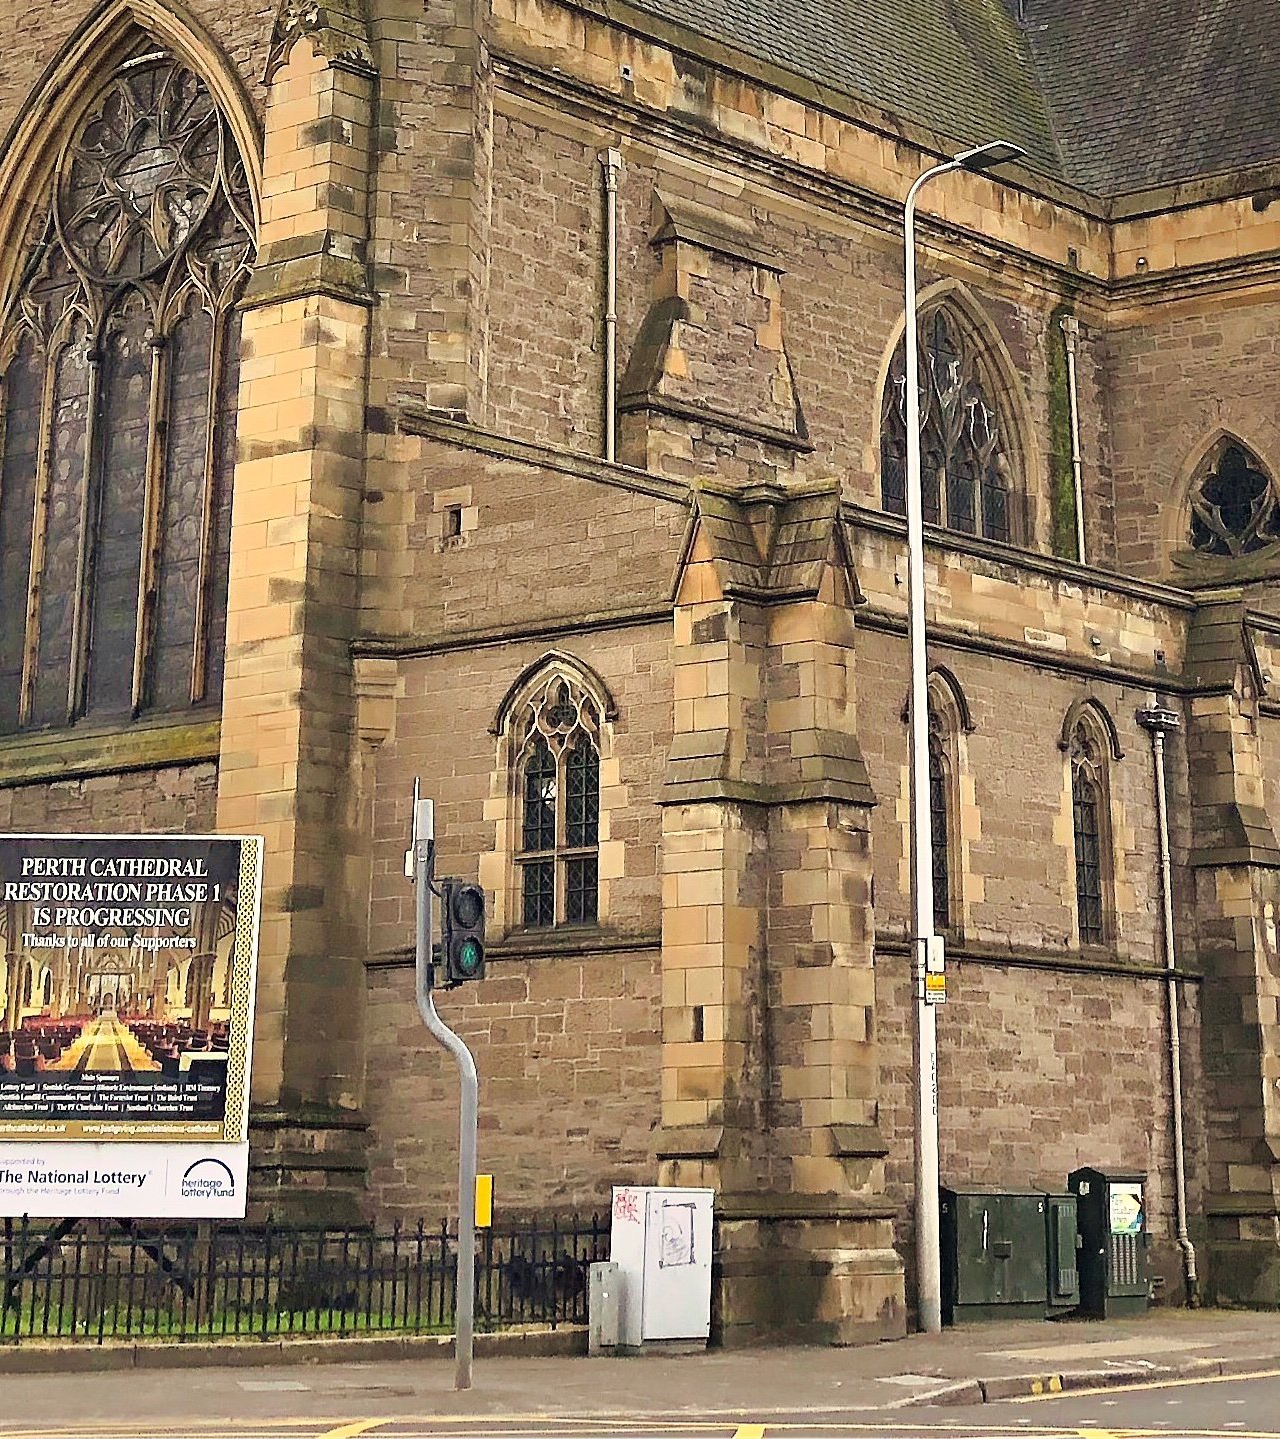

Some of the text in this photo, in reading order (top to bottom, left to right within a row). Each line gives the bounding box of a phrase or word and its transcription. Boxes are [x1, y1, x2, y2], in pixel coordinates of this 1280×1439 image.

[21, 858, 208, 877] PERTH CATHEDRAL
[4, 882, 221, 902] RESTORATION PHASE 1
[32, 907, 190, 927] IS PROGRESSING
[22, 933, 197, 952] Thanks to all of our Supporters
[28, 1170, 88, 1183] National
[94, 1171, 146, 1187] Lottery
